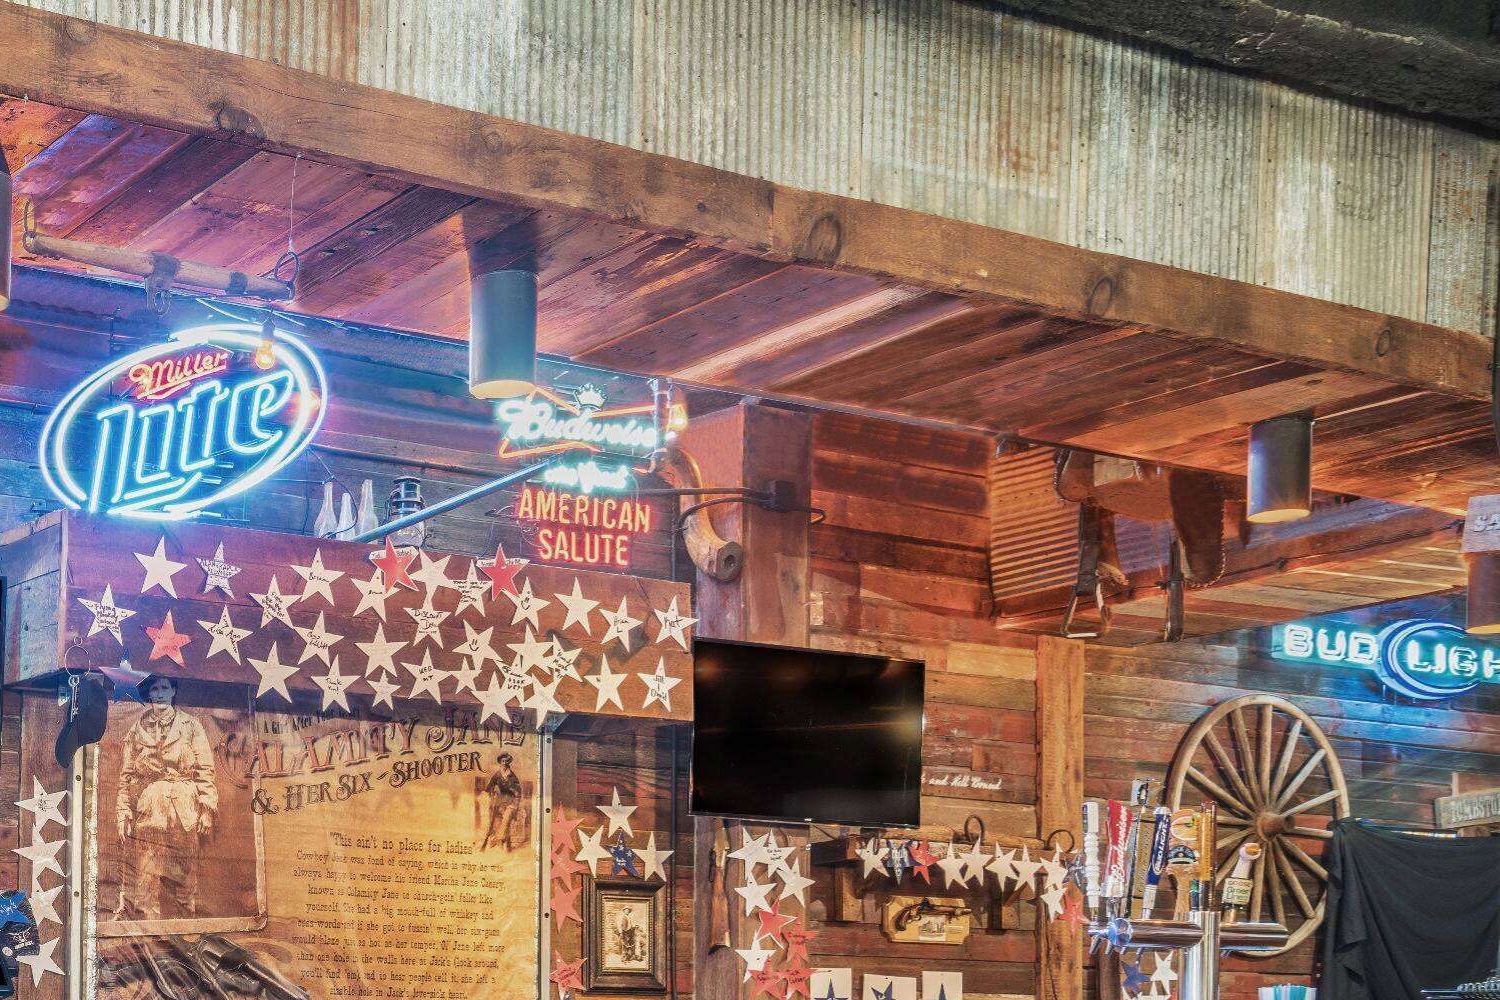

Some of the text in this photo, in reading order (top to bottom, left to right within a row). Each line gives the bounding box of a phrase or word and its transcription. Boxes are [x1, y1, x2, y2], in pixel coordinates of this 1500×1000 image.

[129, 351, 228, 397] Miller
[89, 370, 294, 513] Lite
[518, 489, 651, 533] AMERICAN
[539, 529, 629, 566] SALUTE
[1283, 623, 1500, 679] BUD LIGH
[426, 706, 526, 753] JANE
[251, 789, 278, 815] &
[284, 781, 335, 812] HER
[398, 837, 424, 855] place
